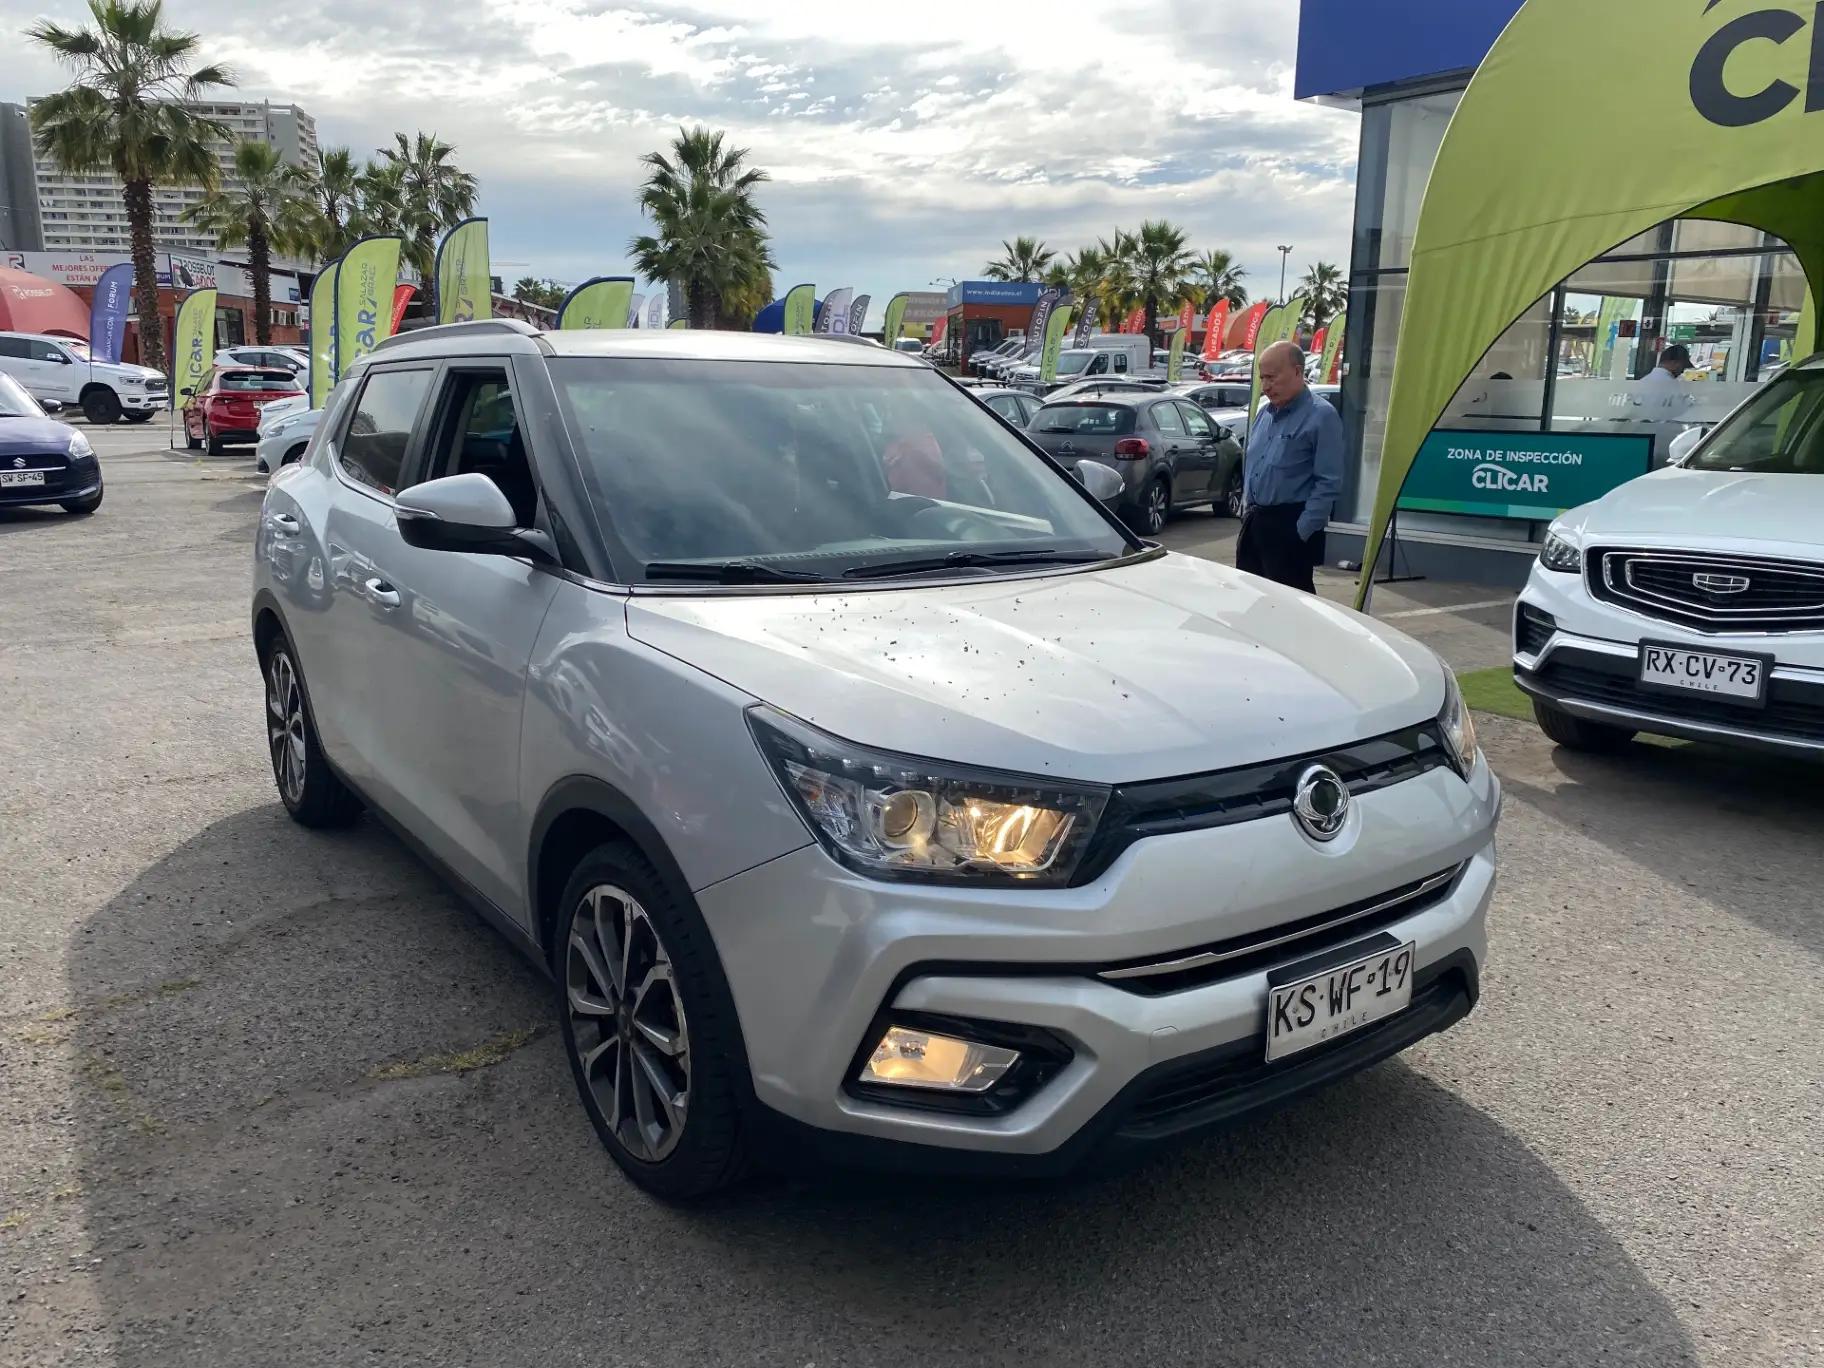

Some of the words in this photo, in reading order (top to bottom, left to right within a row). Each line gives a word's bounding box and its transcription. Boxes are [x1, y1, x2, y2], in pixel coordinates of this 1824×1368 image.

[52, 264, 87, 272] MEJORES
[106, 281, 118, 309] FORUM
[1211, 312, 1222, 352] USADOS
[1247, 311, 1260, 345] USADOS
[1447, 448, 1482, 460] ZONA
[1486, 450, 1503, 461] DE
[1506, 451, 1582, 465] INSPECCIÓN
[1472, 467, 1549, 493] CLICAR
[1680, 679, 1719, 691] CHILE
[1320, 1011, 1368, 1038] CHILE
